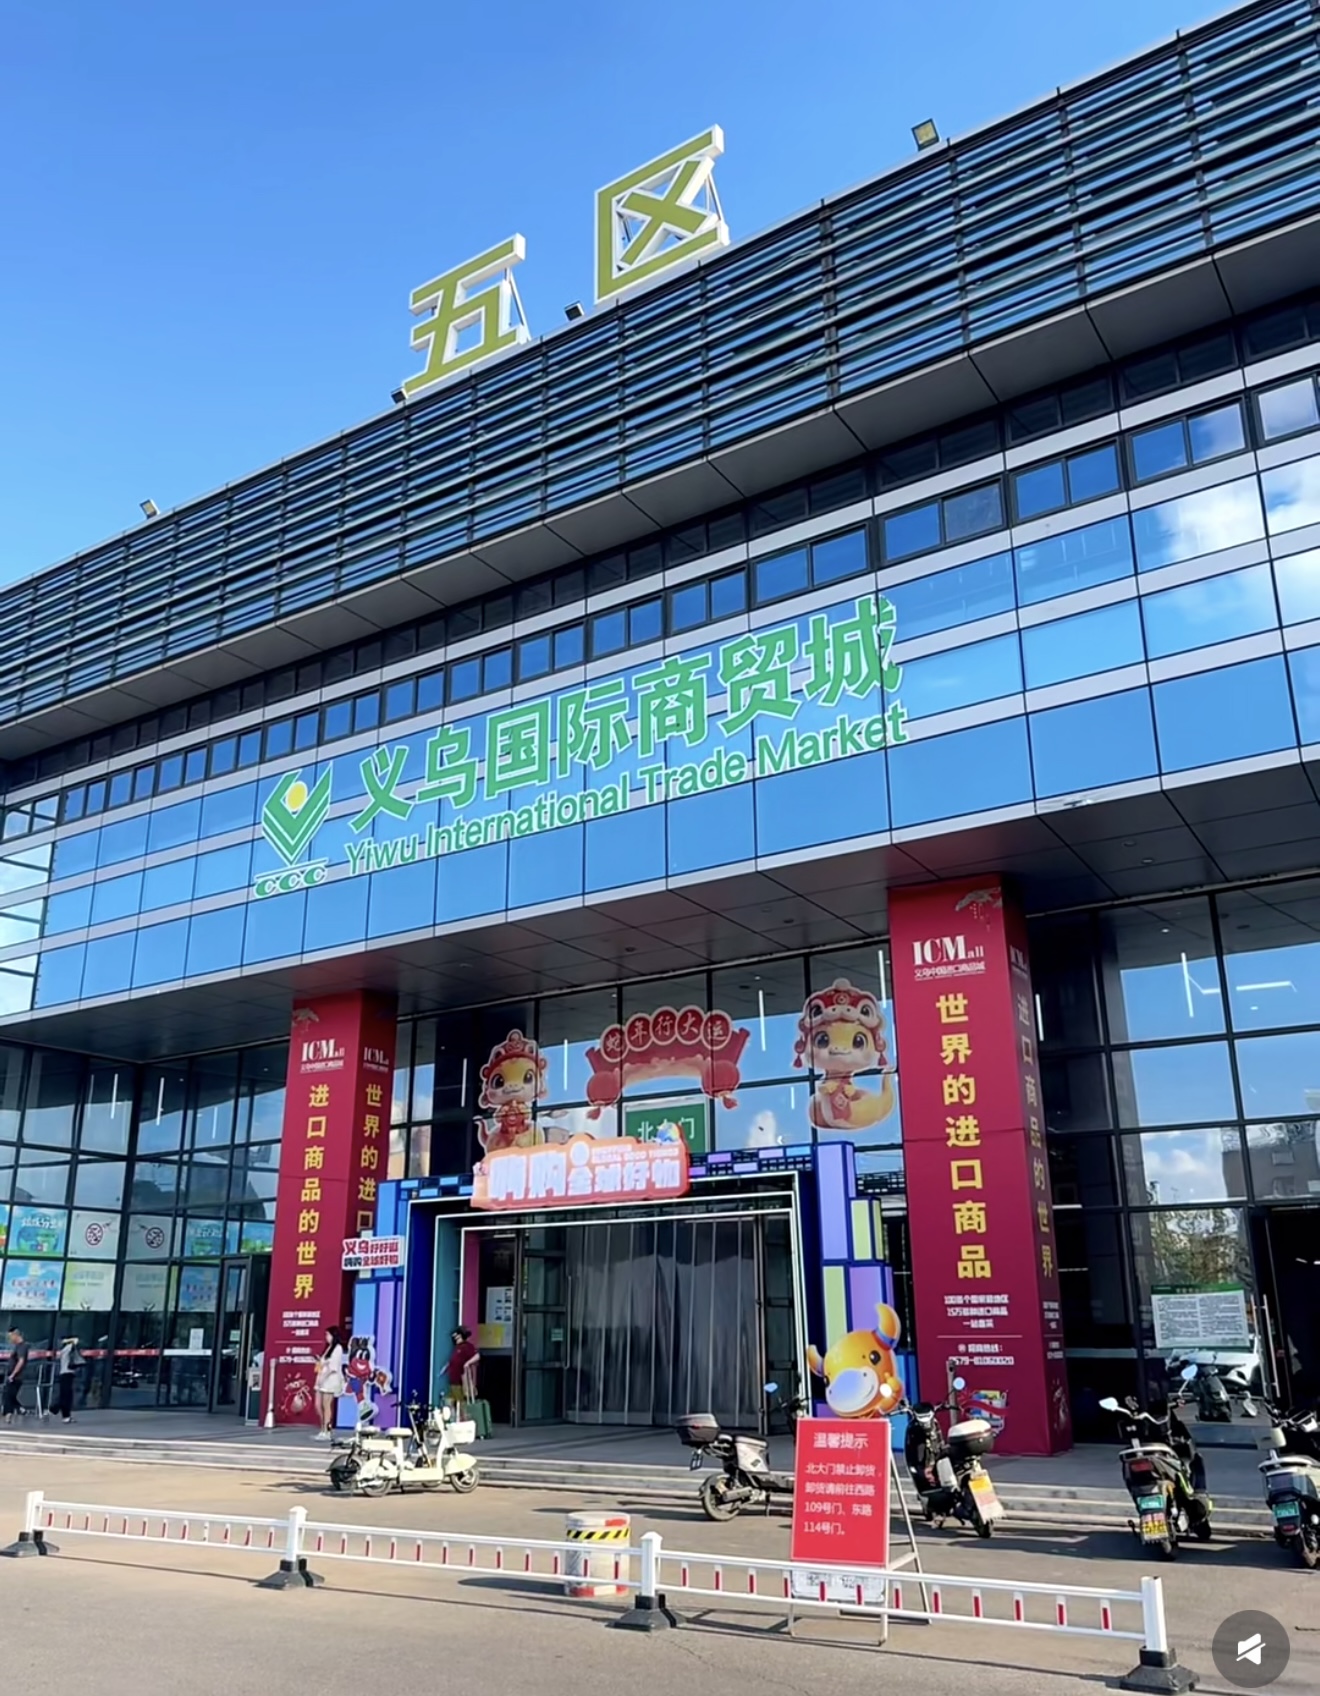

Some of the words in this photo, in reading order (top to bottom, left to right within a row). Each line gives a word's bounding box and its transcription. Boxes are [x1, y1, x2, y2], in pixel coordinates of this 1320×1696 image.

[401, 124, 729, 398] 五区
[344, 834, 419, 876] Yiwu
[425, 777, 628, 858] International
[639, 745, 748, 802] Trade
[755, 704, 907, 768] Market
[347, 596, 902, 833] 义乌国际商贸城
[605, 1012, 726, 1051] 蛇年行大运
[913, 935, 984, 966] ICMall
[293, 1084, 329, 1299] 进口商品的世界
[638, 1117, 695, 1142] 北门
[936, 993, 991, 1279] 世界的进口商品
[813, 1432, 869, 1450] 温馨提示
